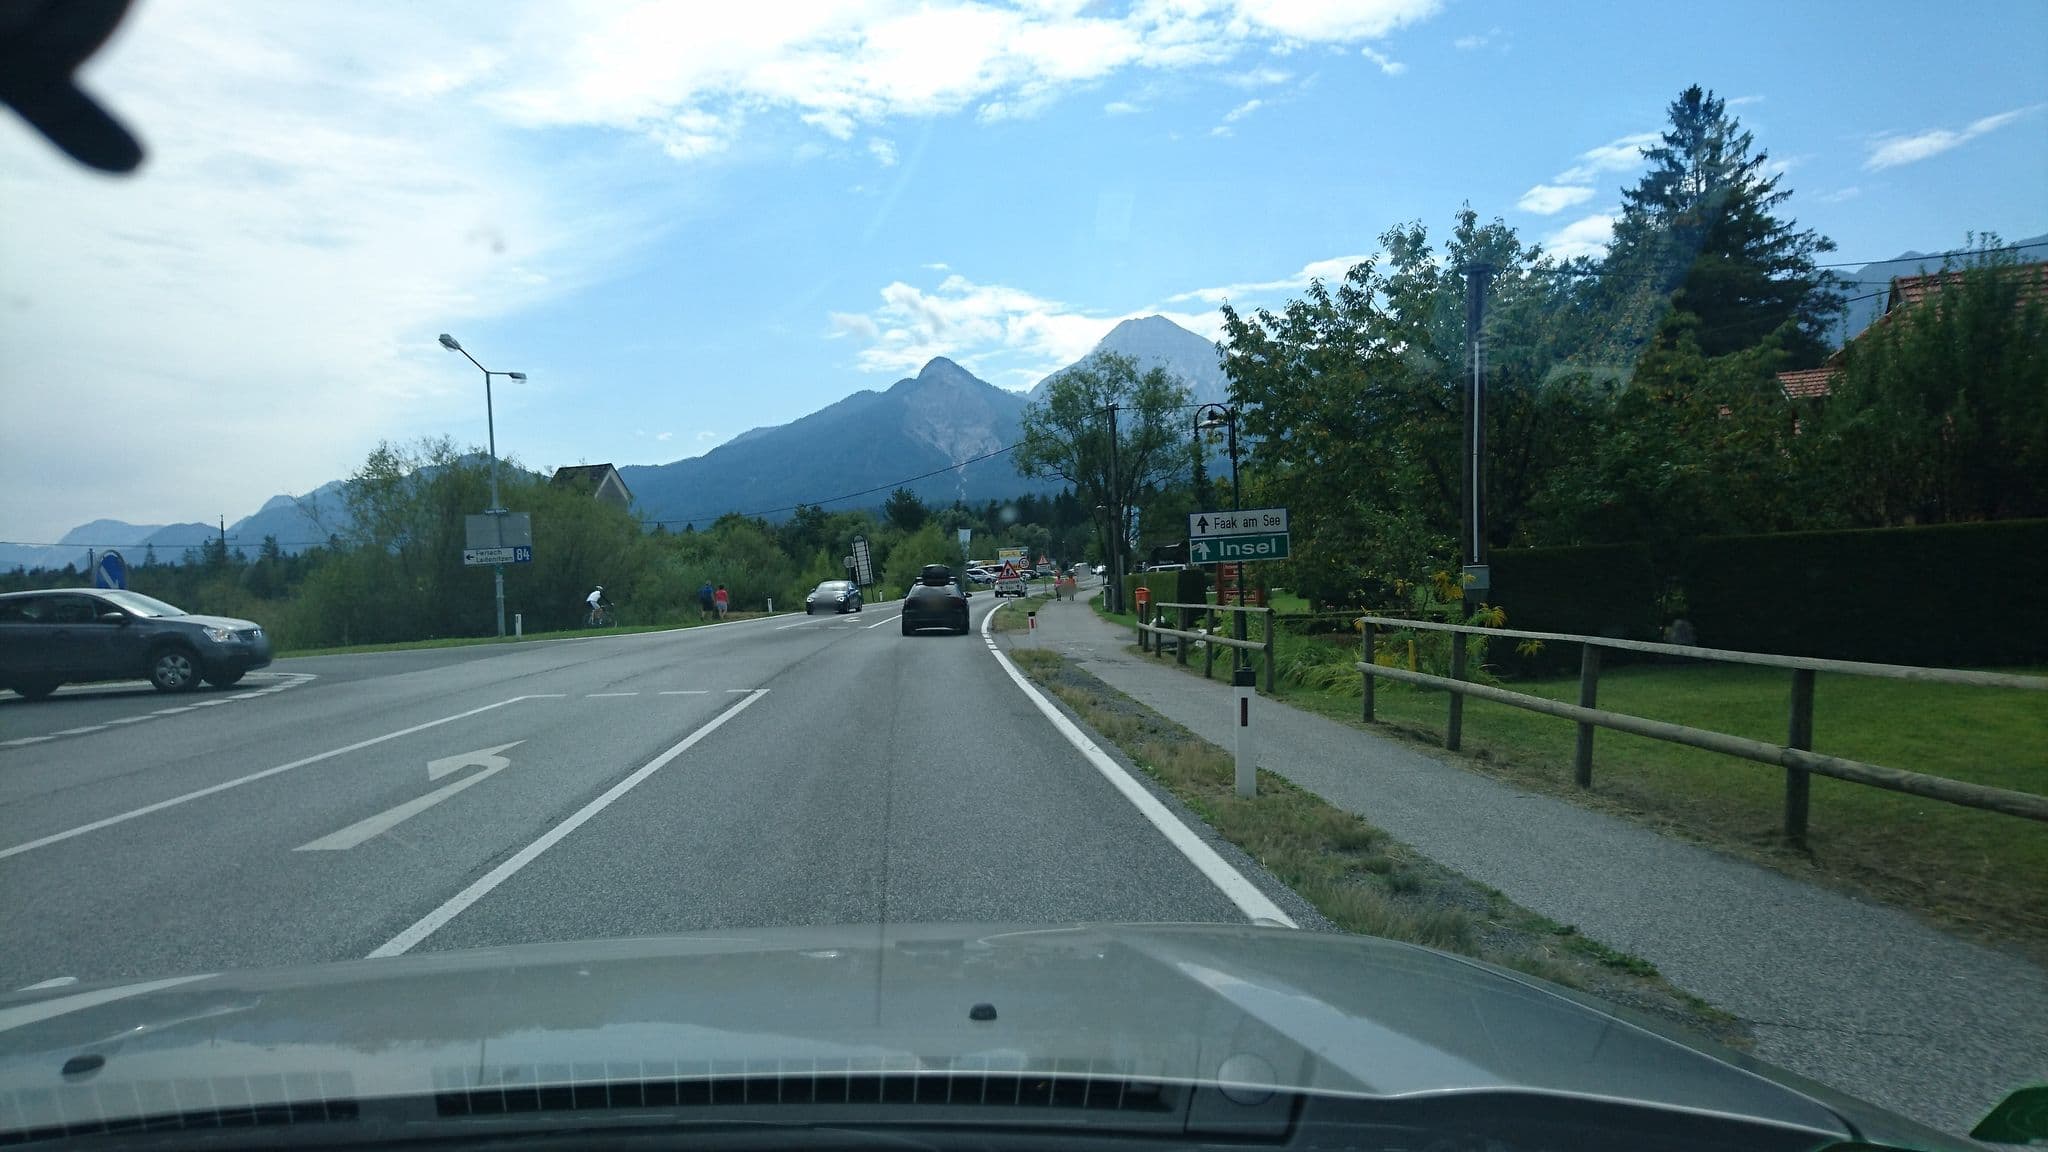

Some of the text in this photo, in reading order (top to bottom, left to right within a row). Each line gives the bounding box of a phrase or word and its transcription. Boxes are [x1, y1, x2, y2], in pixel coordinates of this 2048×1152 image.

[1214, 514, 1280, 529] Faak am See
[516, 548, 530, 560] 84
[1219, 538, 1276, 556] Insel
